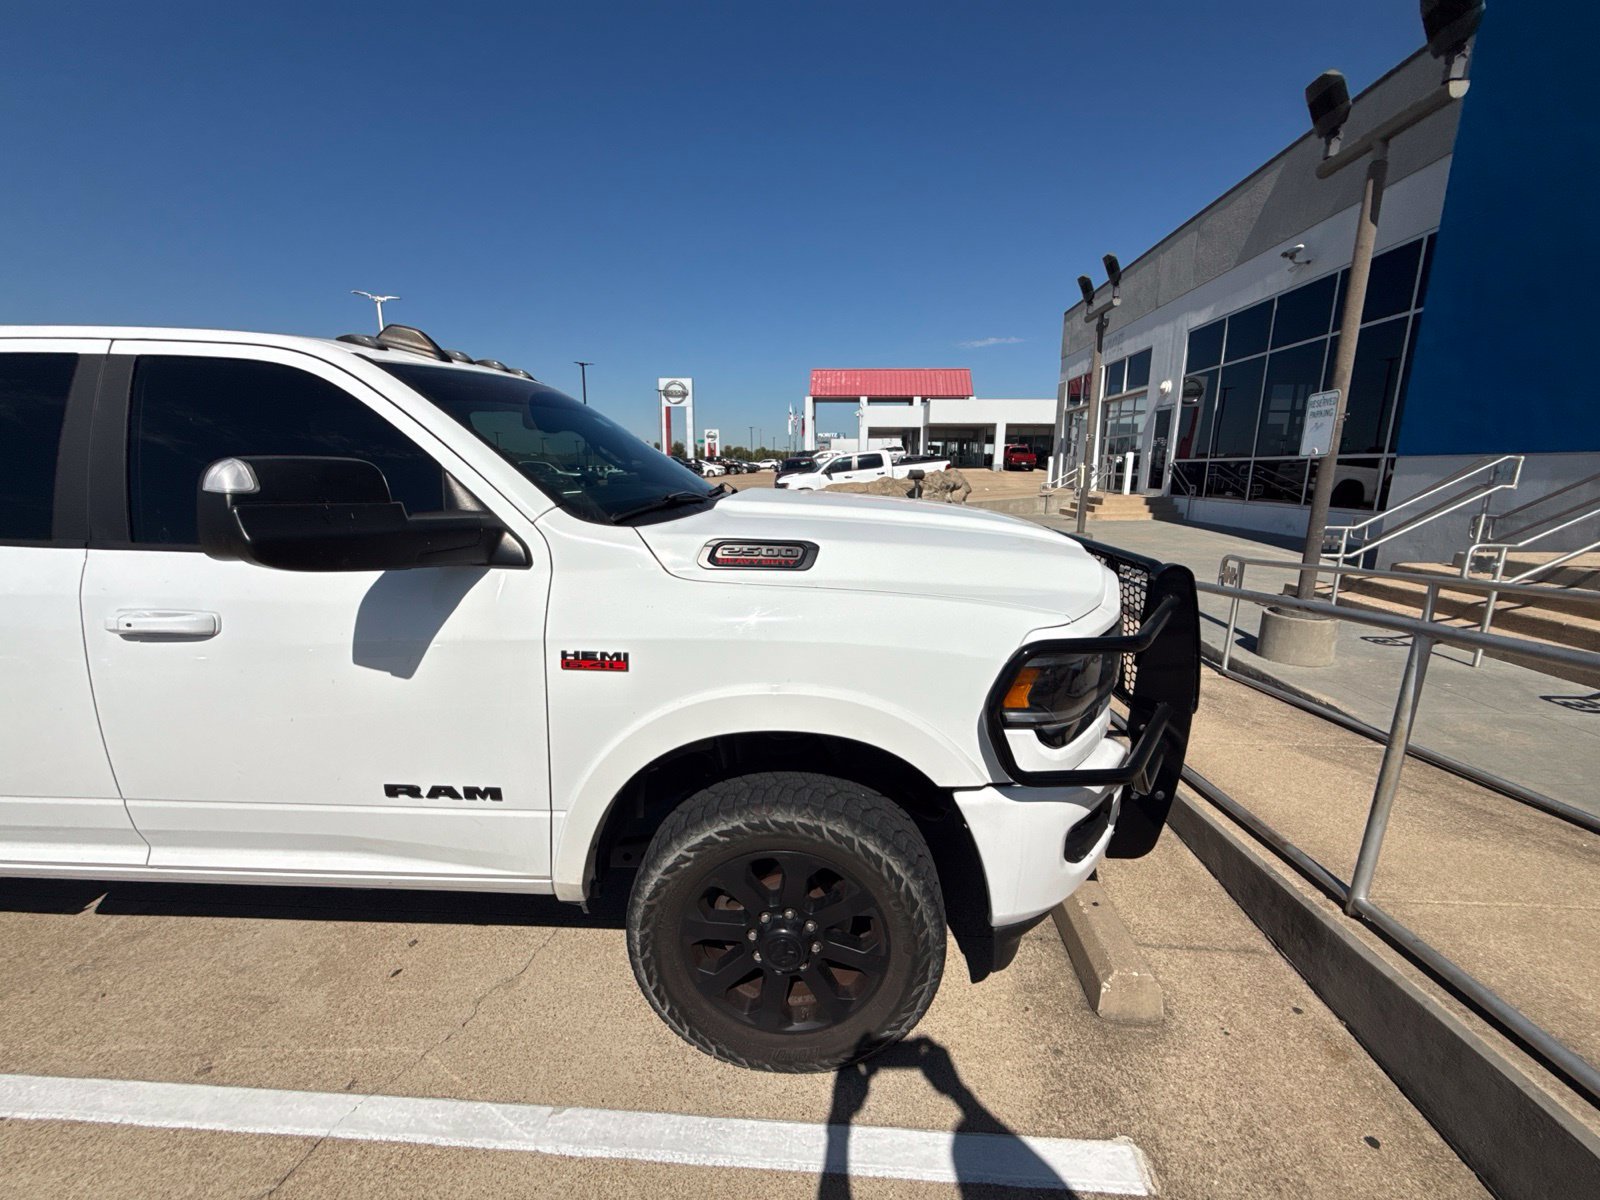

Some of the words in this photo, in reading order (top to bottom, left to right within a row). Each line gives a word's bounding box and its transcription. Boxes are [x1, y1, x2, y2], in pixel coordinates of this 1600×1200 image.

[721, 547, 800, 557] 2500
[761, 558, 797, 566] DUTY
[561, 650, 629, 662] HEMI
[383, 784, 503, 801] RAM
